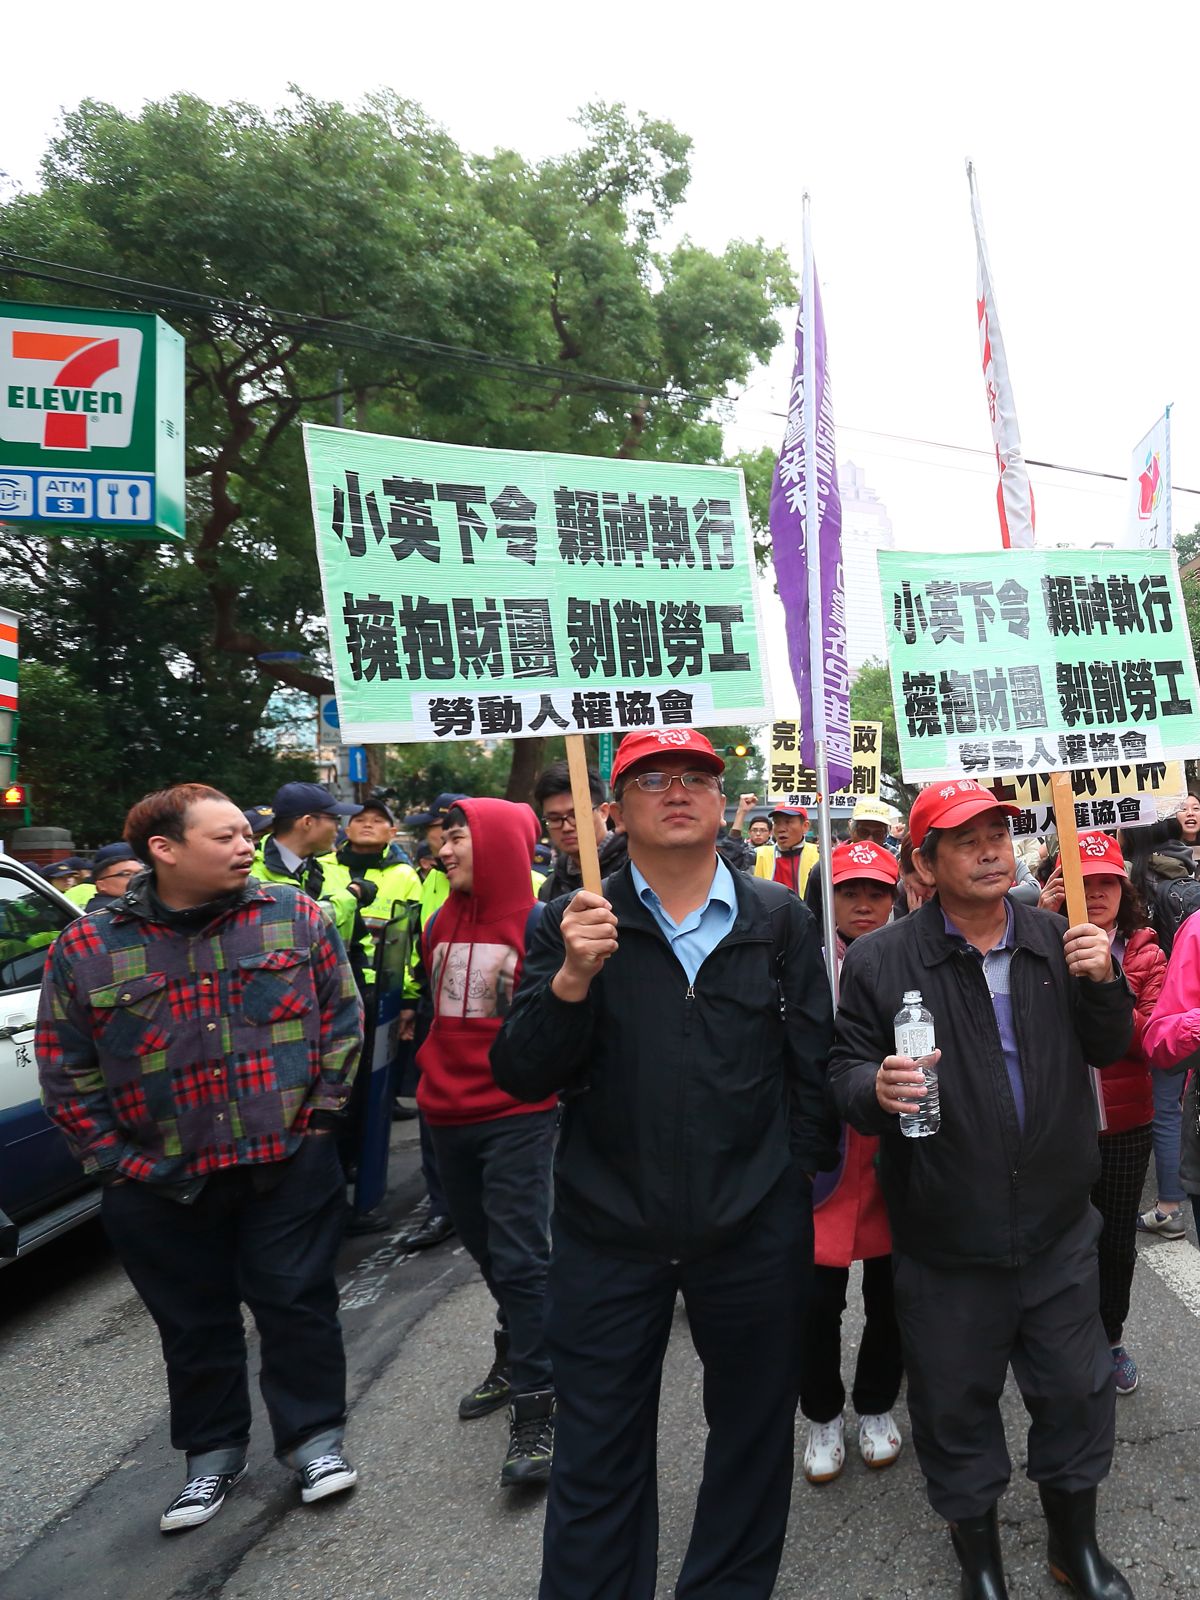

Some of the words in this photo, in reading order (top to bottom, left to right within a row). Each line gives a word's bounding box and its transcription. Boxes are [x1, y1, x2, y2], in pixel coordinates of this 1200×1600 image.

[12, 331, 120, 449] 7
[0, 489, 27, 501] i-Fi
[46, 481, 86, 494] ATM
[332, 470, 539, 566] 小英下令
[554, 485, 736, 571] 賴神執行
[893, 578, 1030, 645] 小英下令
[1041, 575, 1173, 636] 賴神執行
[343, 592, 560, 682] 擁抱財團
[567, 597, 752, 679] 剝削勞工
[429, 689, 694, 737] 勞動人權協會
[902, 665, 1049, 738] 擁抱財團
[1055, 661, 1192, 727] 剝削勞工
[772, 721, 878, 754] 完政
[959, 731, 1148, 772] 勞動人權協會
[771, 763, 876, 794] 完全削
[1007, 797, 1141, 835] 動人權協會
